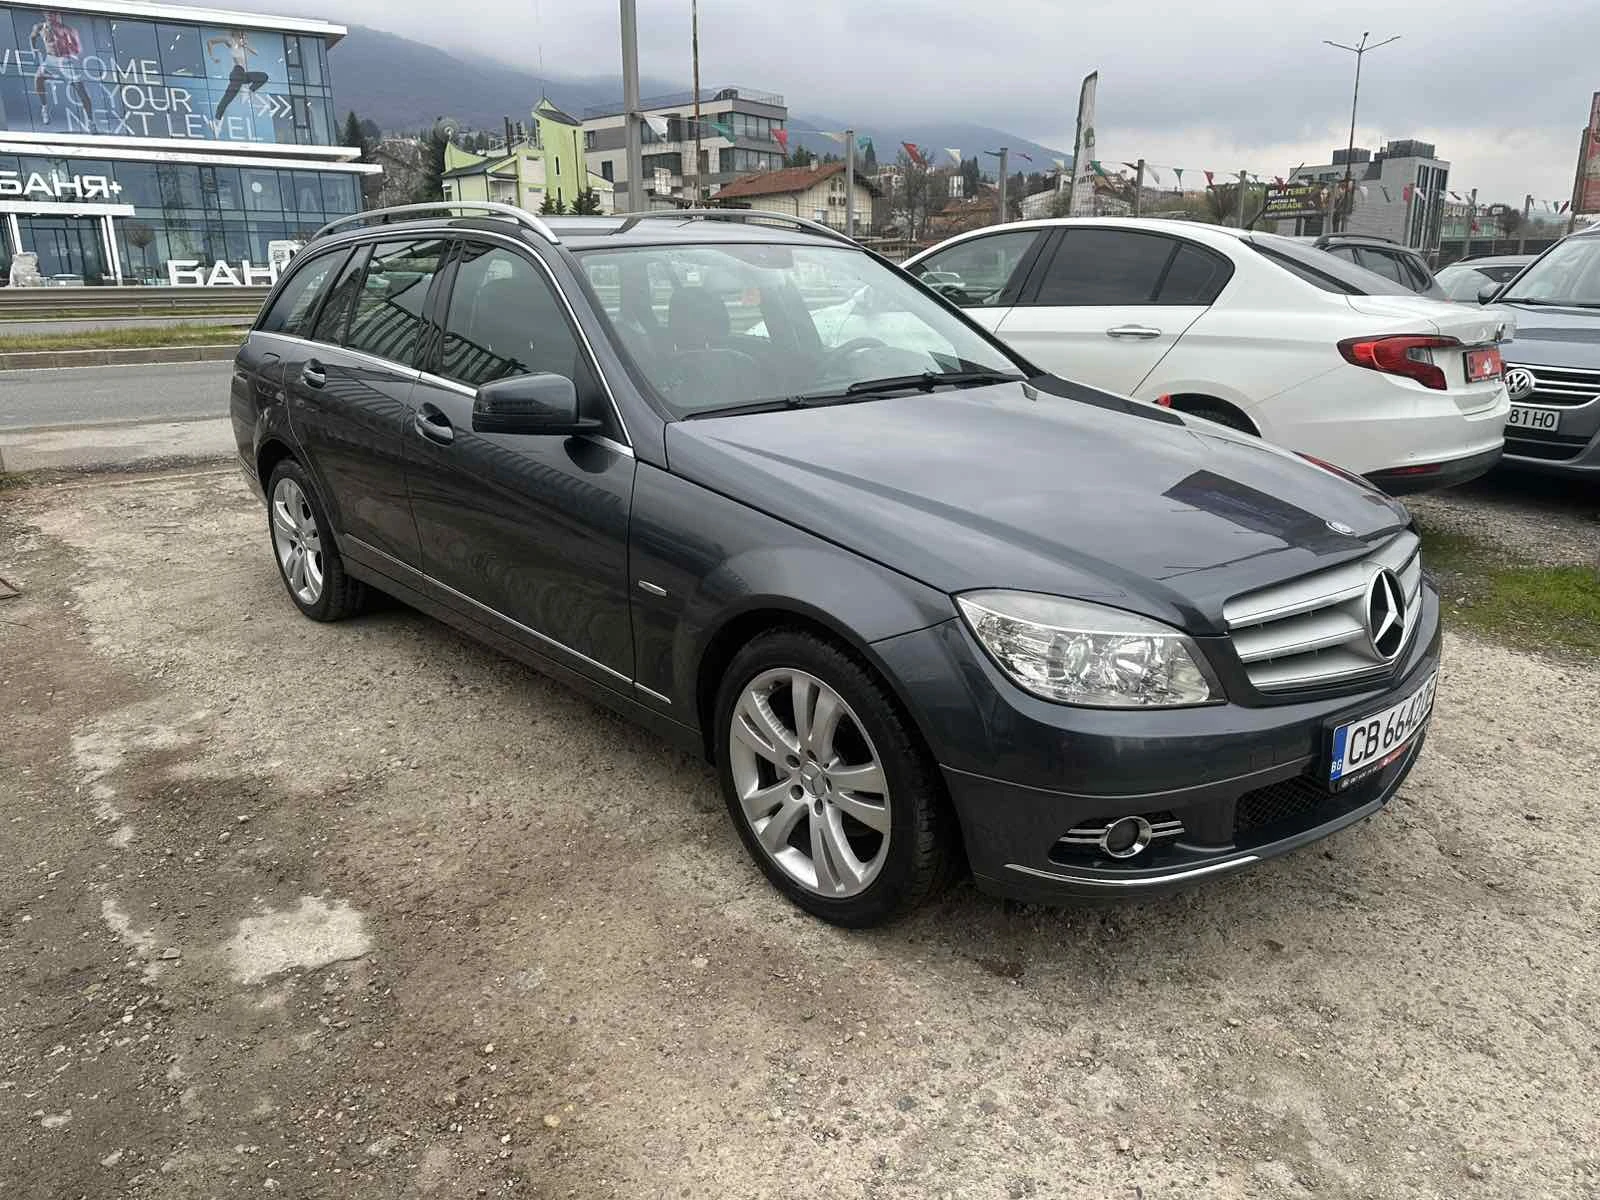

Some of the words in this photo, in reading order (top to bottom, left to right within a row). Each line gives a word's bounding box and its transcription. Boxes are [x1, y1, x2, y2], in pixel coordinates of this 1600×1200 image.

[100, 81, 192, 112] YOUR
[65, 107, 155, 136] NEXT
[166, 112, 264, 141] LEVEL
[167, 259, 279, 287] БАН
[1331, 759, 1342, 773] BG
